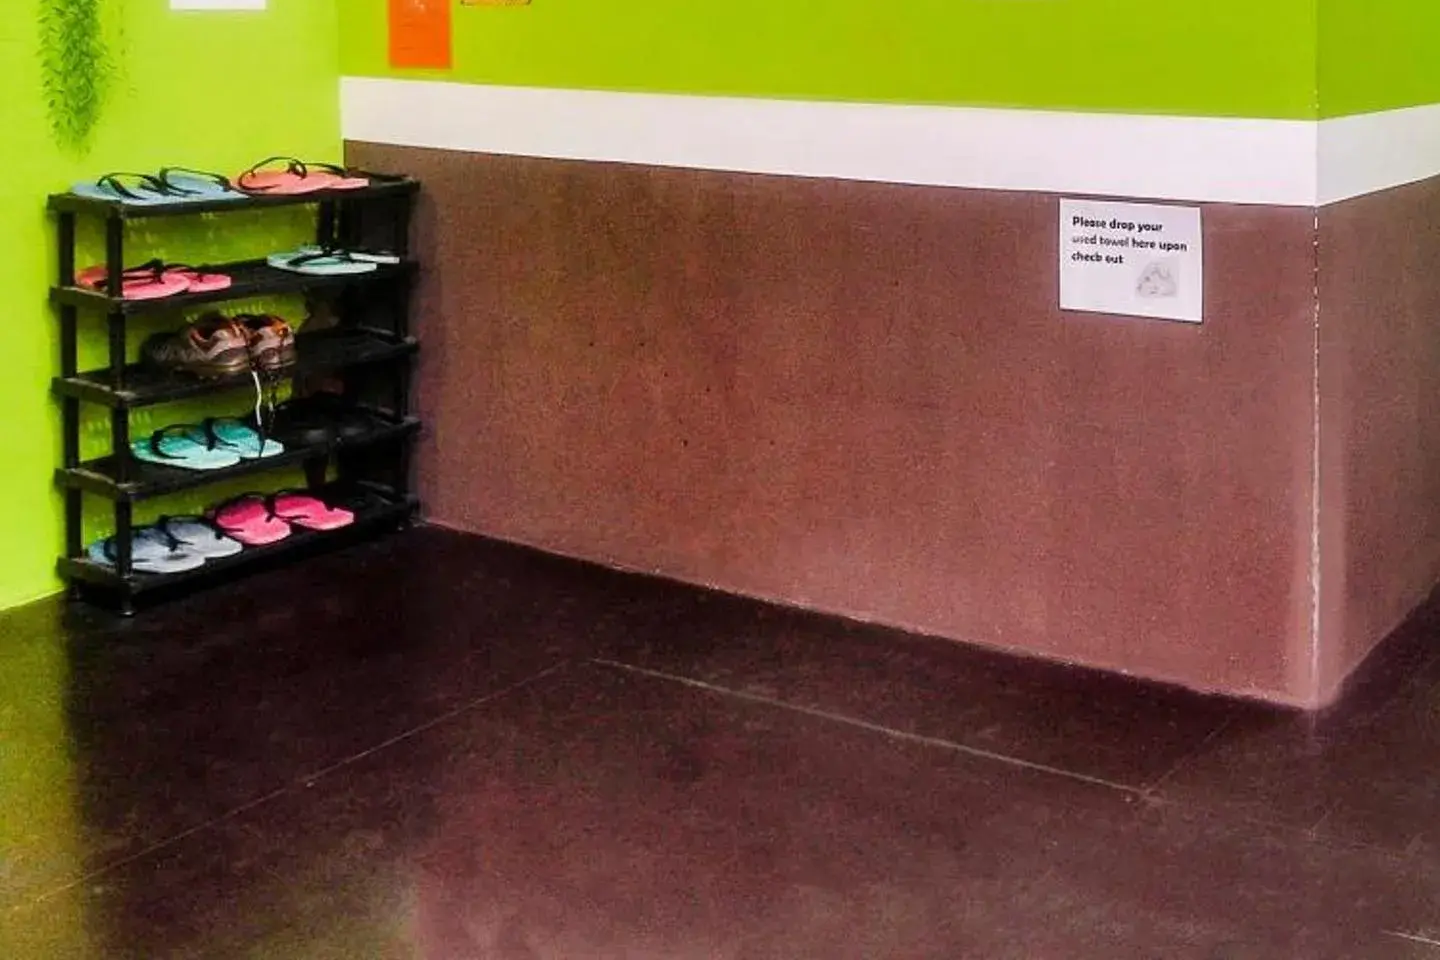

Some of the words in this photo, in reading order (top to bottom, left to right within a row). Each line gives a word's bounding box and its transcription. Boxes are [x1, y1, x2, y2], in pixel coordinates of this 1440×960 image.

[1072, 216, 1106, 228] Please
[1109, 219, 1135, 232] drop
[1137, 223, 1163, 233] your
[1072, 235, 1097, 245] used
[1100, 237, 1130, 247] towel
[1132, 238, 1156, 249] here
[1159, 241, 1187, 252] upon
[1071, 251, 1102, 262] check
[1105, 253, 1124, 264] out
